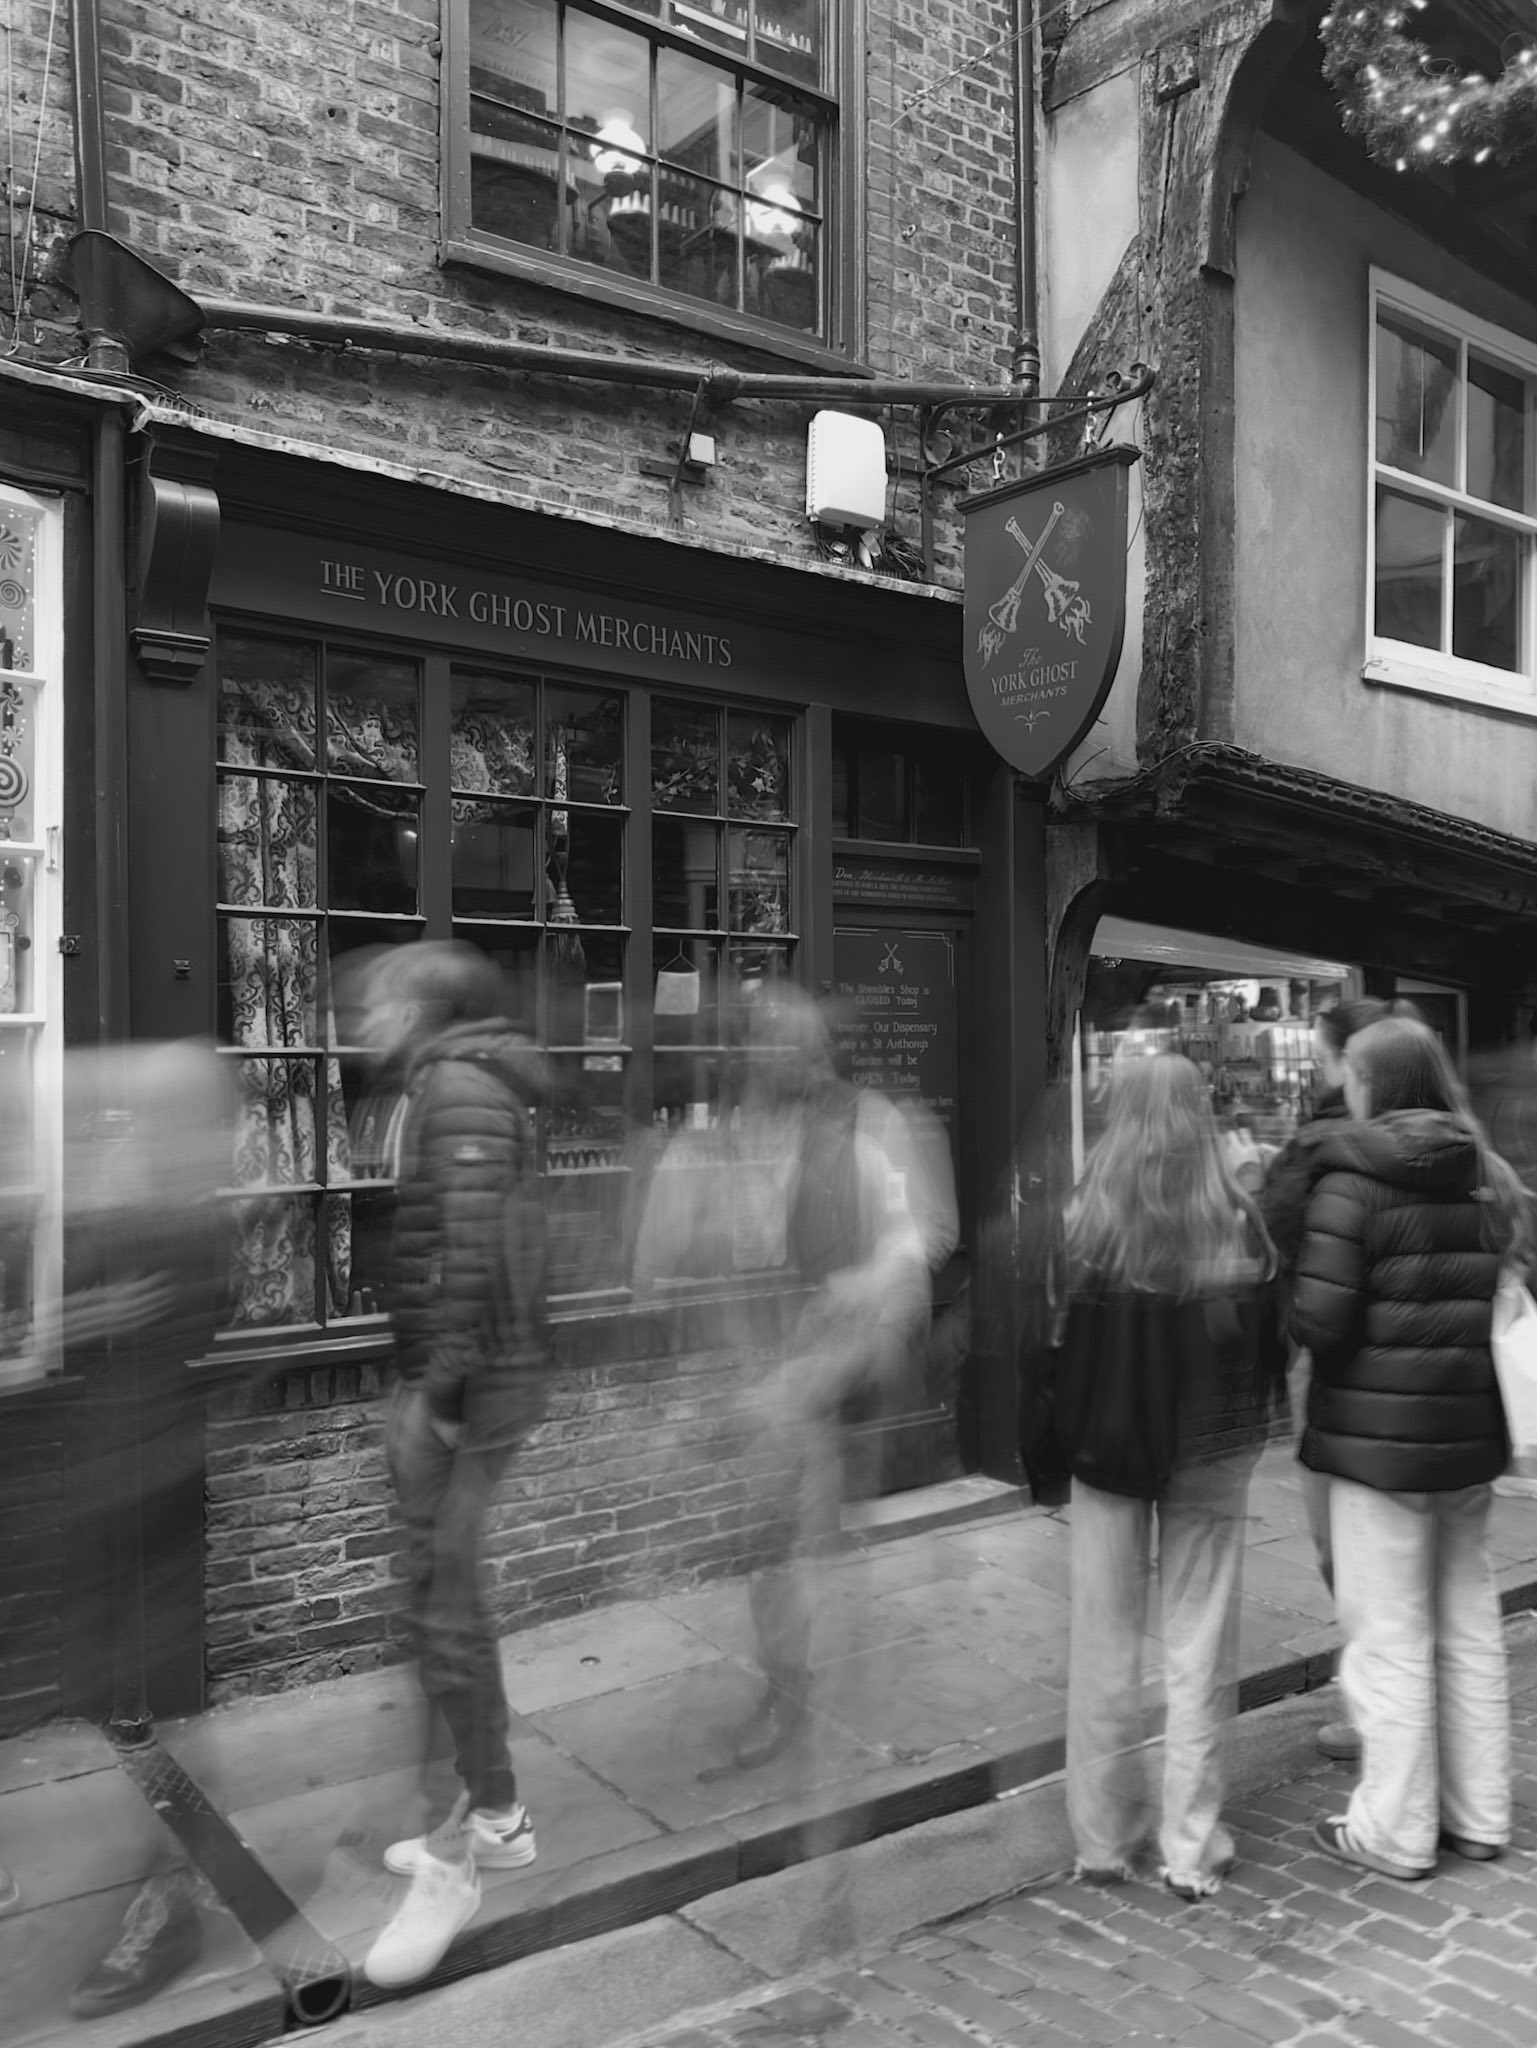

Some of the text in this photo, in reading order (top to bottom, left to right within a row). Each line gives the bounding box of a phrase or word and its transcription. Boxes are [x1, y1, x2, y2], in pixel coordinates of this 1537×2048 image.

[320, 560, 732, 667] THE YORK GHOST MERCHANTS
[1019, 647, 1041, 668] The
[991, 660, 1078, 695] YORK GHOST
[1001, 685, 1067, 706] MERCHANTS
[900, 984, 919, 997] Shop
[855, 995, 918, 1008] CLOSED Today
[874, 1021, 889, 1033] Our
[893, 1021, 937, 1036] Dispensary
[907, 1053, 918, 1065] be
